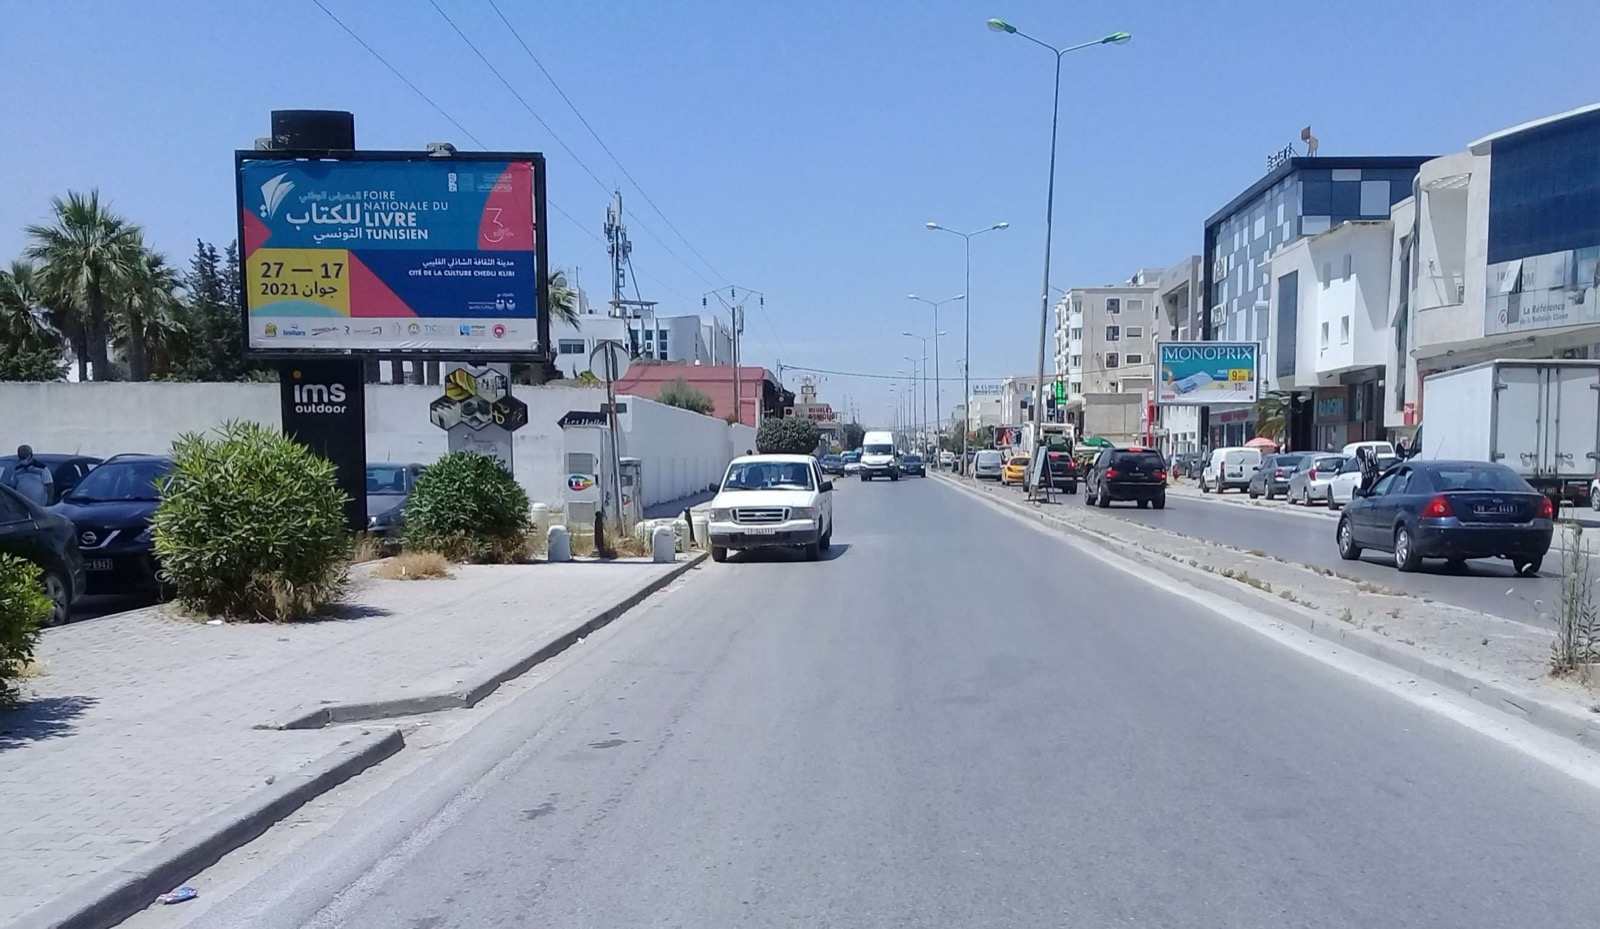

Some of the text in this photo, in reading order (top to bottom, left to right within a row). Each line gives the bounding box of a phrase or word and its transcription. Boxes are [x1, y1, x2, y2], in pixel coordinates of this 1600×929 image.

[363, 190, 395, 200] FOIRE
[364, 201, 448, 211] NATIONALE DU
[286, 202, 361, 231] للكتاب
[364, 212, 417, 227] LIVRE
[313, 227, 362, 244] التونسي
[366, 229, 429, 240] TUNISIEN
[260, 262, 284, 278] 27
[320, 263, 344, 279] 17
[260, 282, 298, 295] 2021
[302, 280, 338, 299] جوان
[1523, 306, 1530, 315] La
[1164, 347, 1251, 361] MONOPRIX
[1231, 370, 1238, 381] 9
[293, 370, 347, 403] ims
[295, 403, 347, 414] outdoor
